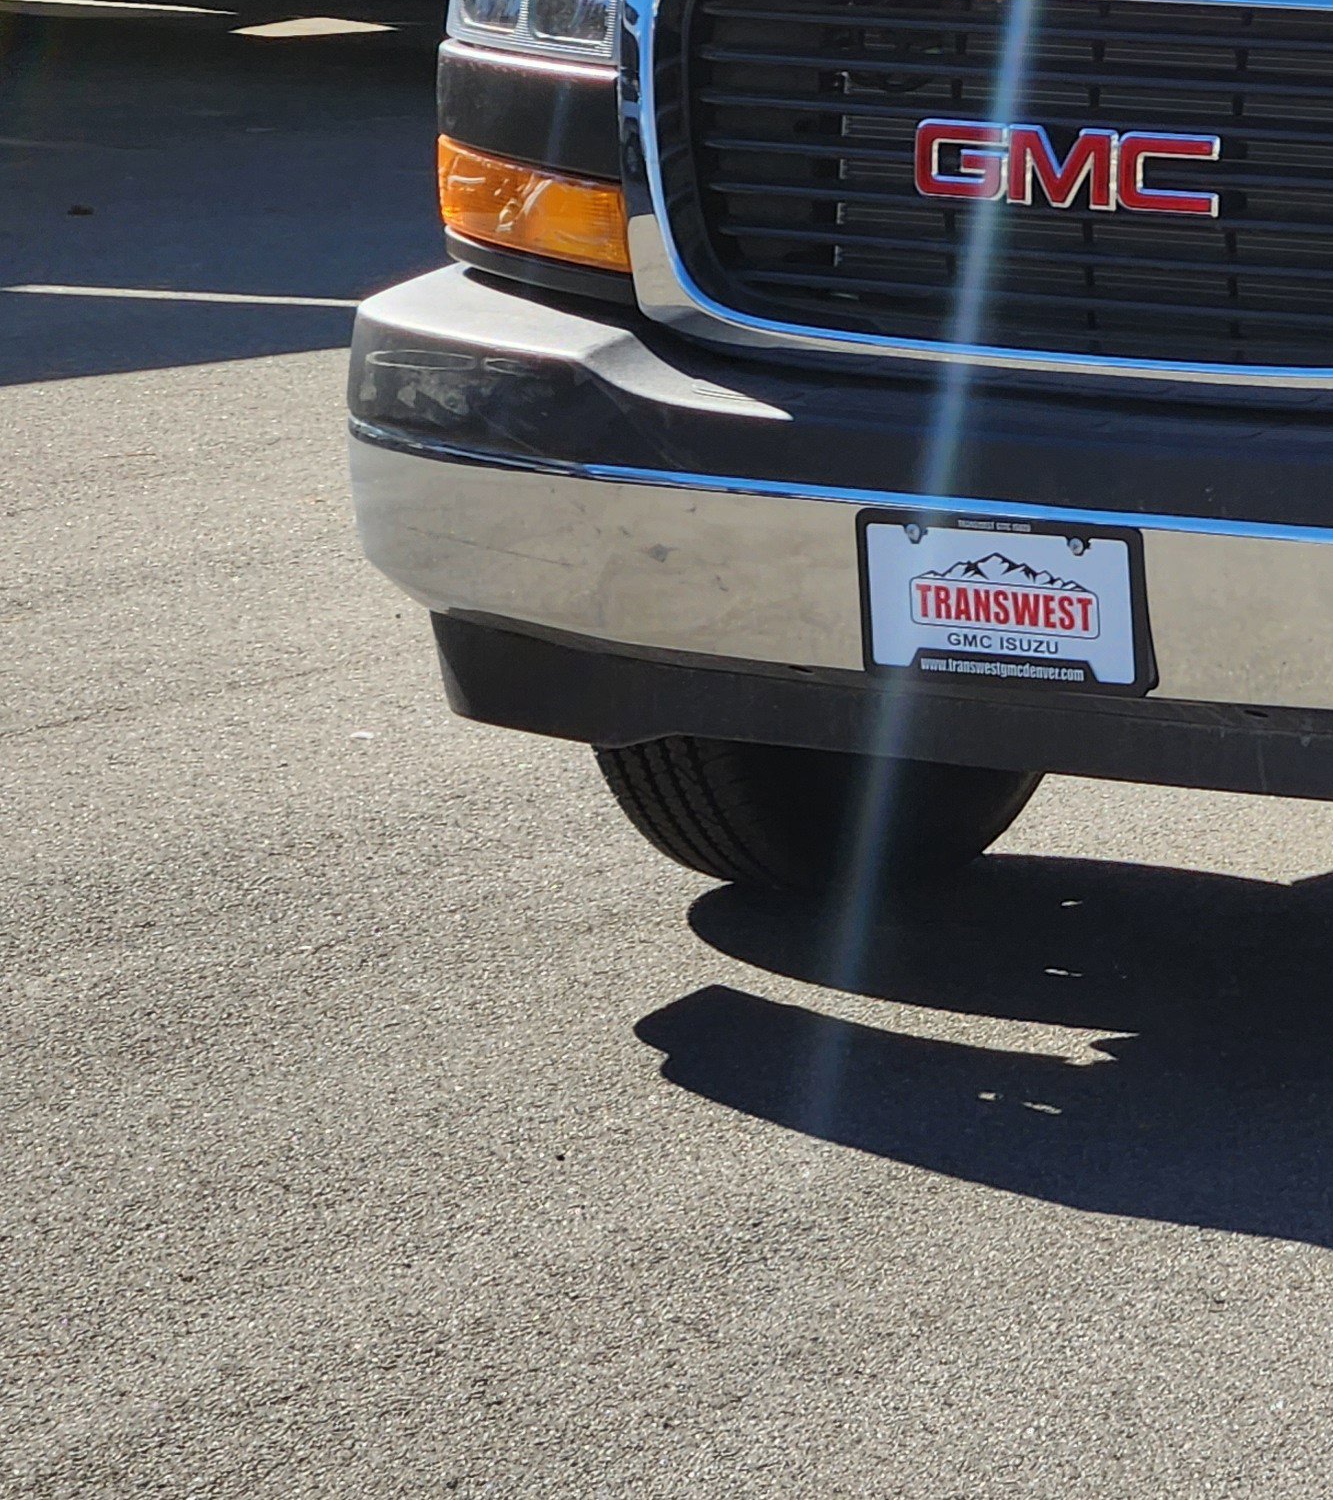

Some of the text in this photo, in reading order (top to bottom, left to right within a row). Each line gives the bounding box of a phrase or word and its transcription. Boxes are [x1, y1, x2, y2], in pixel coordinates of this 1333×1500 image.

[914, 118, 1220, 217] GMC
[915, 583, 1093, 631] TRANSWEST
[947, 632, 1059, 655] GMC ISUZU
[920, 657, 1085, 682] www.transwestgmcdenver.com
